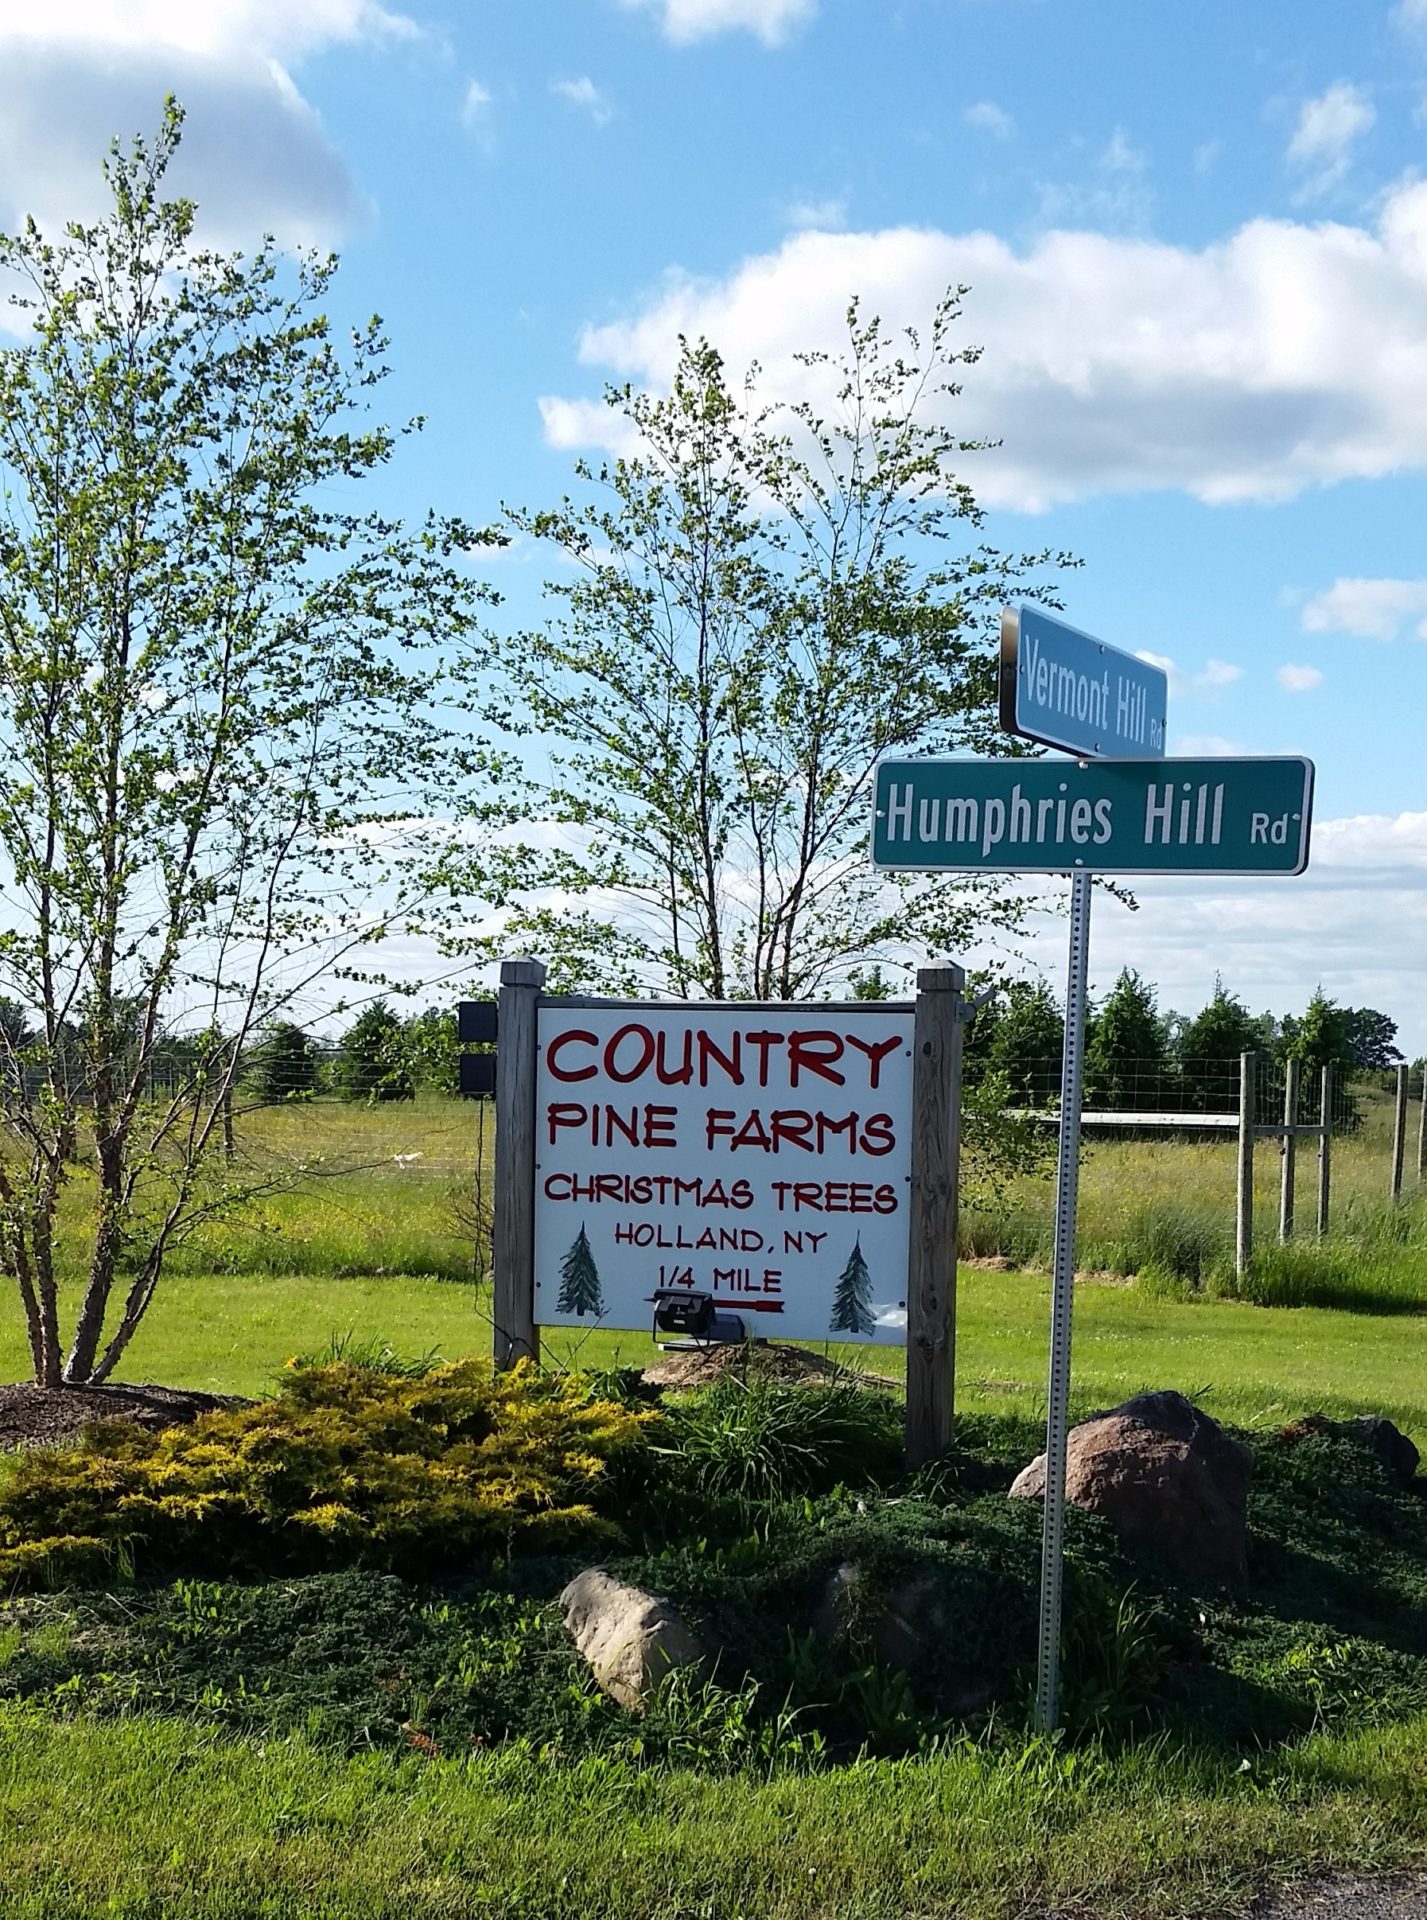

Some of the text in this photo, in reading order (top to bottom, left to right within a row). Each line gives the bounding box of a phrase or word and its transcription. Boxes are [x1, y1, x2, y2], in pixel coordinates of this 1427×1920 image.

[1025, 634, 1162, 750] Vermont Hill Rd
[887, 782, 1288, 858] Humphries Hill Rd
[546, 1023, 903, 1089] COUNTRY
[547, 1103, 896, 1156] PINE FARMS
[544, 1173, 899, 1215] CHRISTMAS TREES
[614, 1222, 828, 1254] HOLLAND, NY
[658, 1265, 782, 1293] 1/4 MILE
